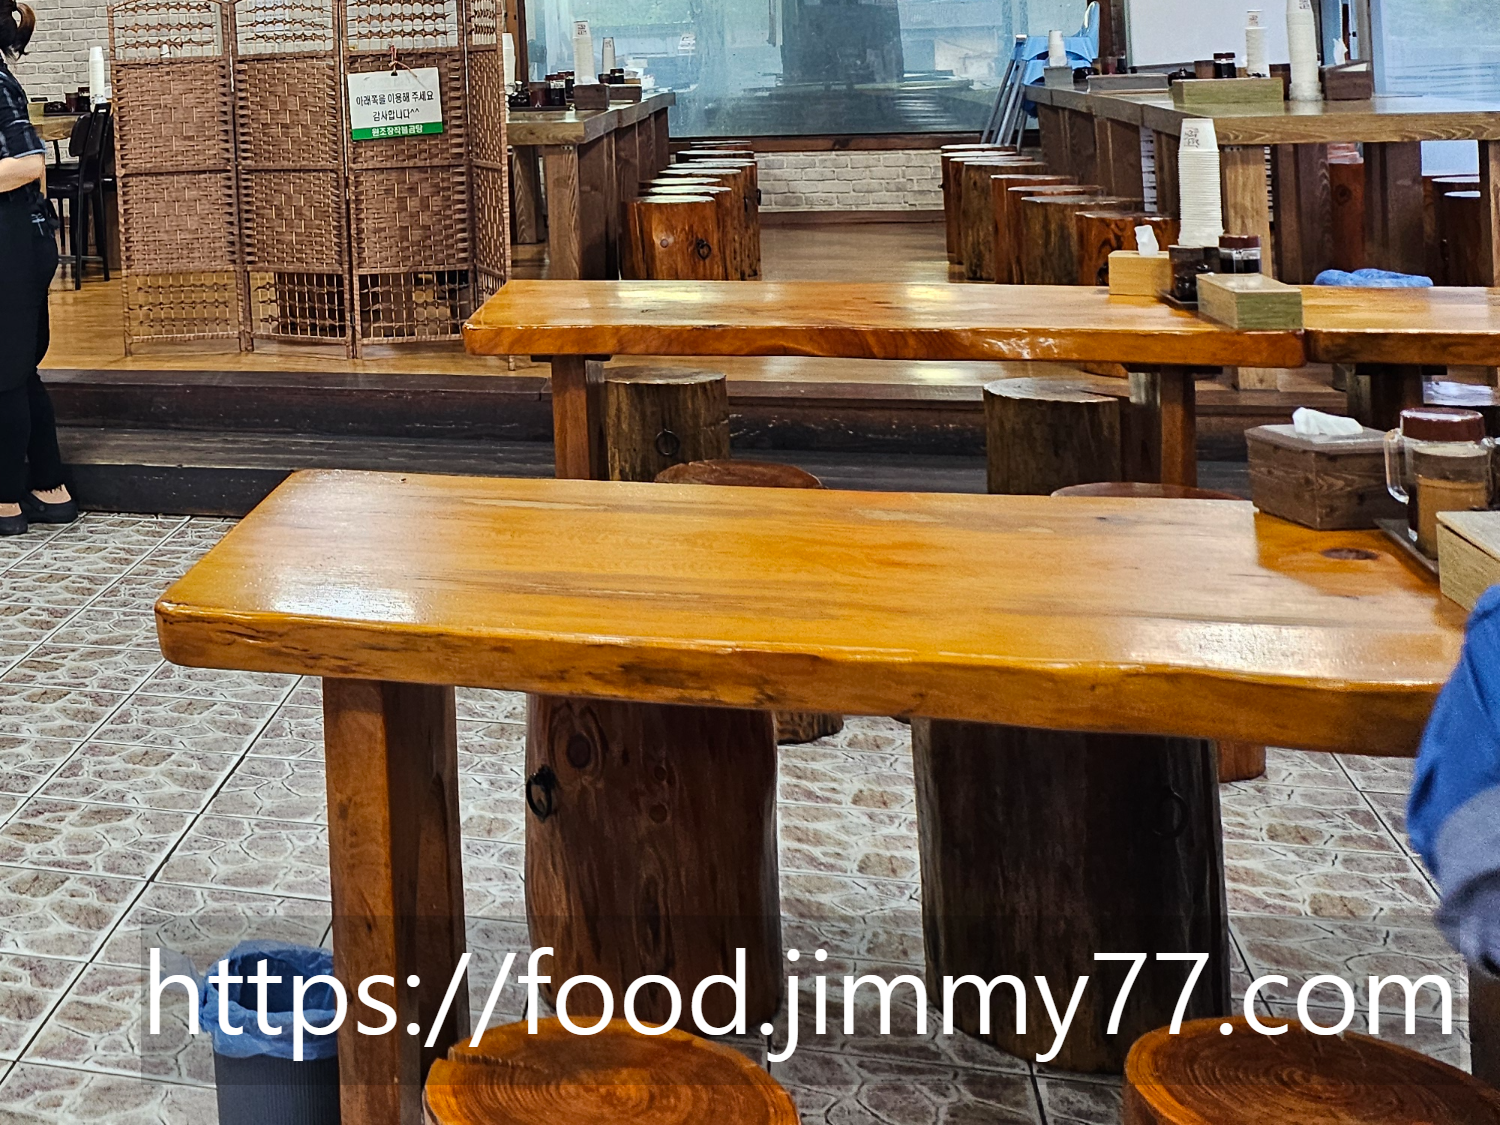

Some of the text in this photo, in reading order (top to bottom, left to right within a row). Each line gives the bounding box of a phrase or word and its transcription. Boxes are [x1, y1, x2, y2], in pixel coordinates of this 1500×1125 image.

[356, 90, 434, 106] 아래쪽을 이용해 주세요
